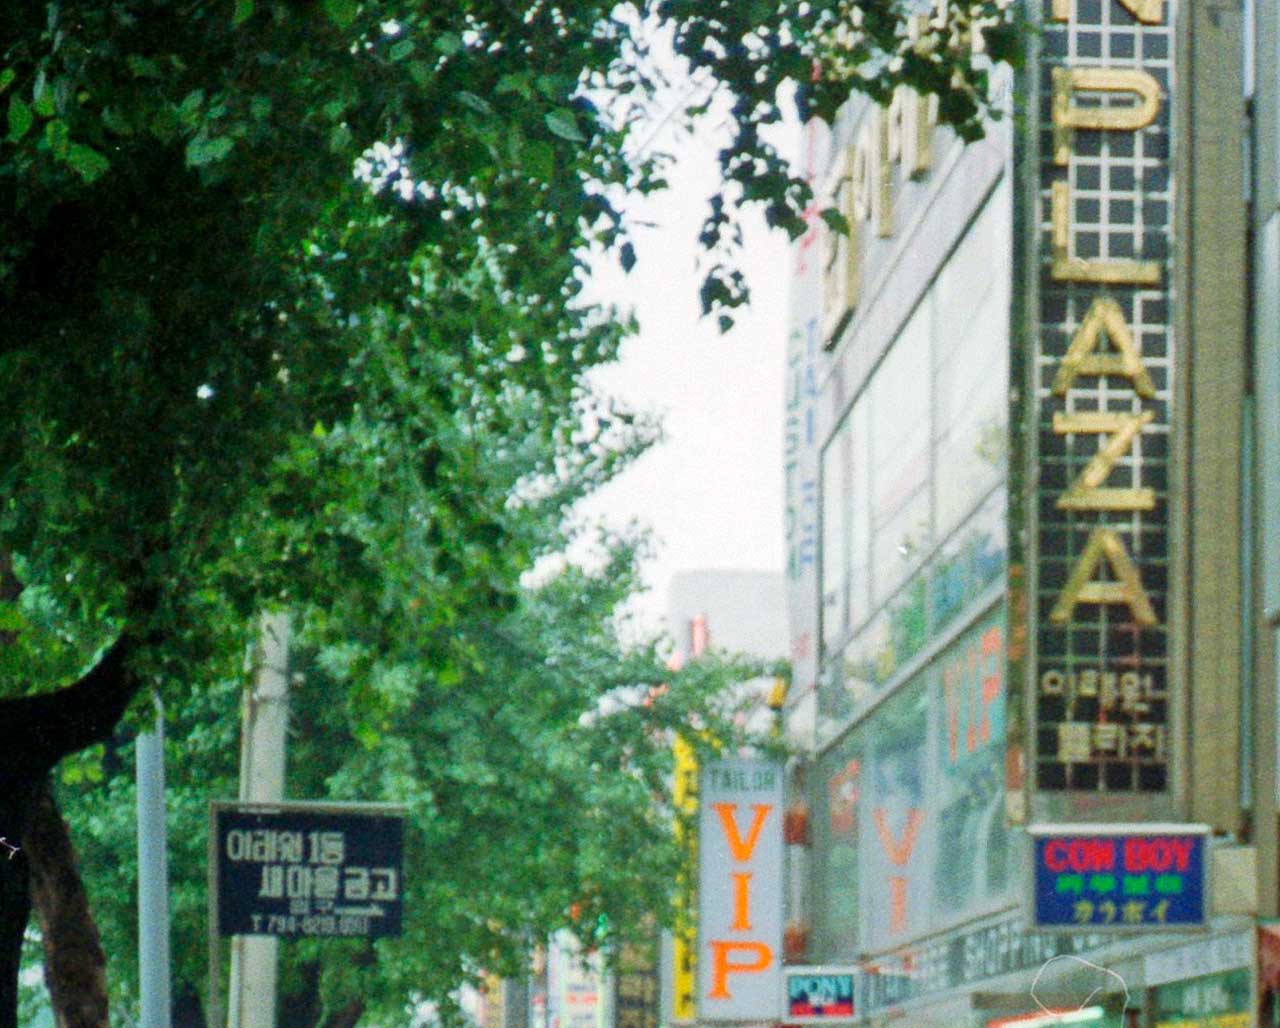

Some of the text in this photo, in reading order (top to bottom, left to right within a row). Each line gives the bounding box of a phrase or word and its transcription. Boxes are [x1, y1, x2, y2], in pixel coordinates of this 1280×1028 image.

[1051, 66, 1163, 626] PLAZA
[708, 802, 774, 1000] VIP
[1122, 836, 1194, 872] BOY
